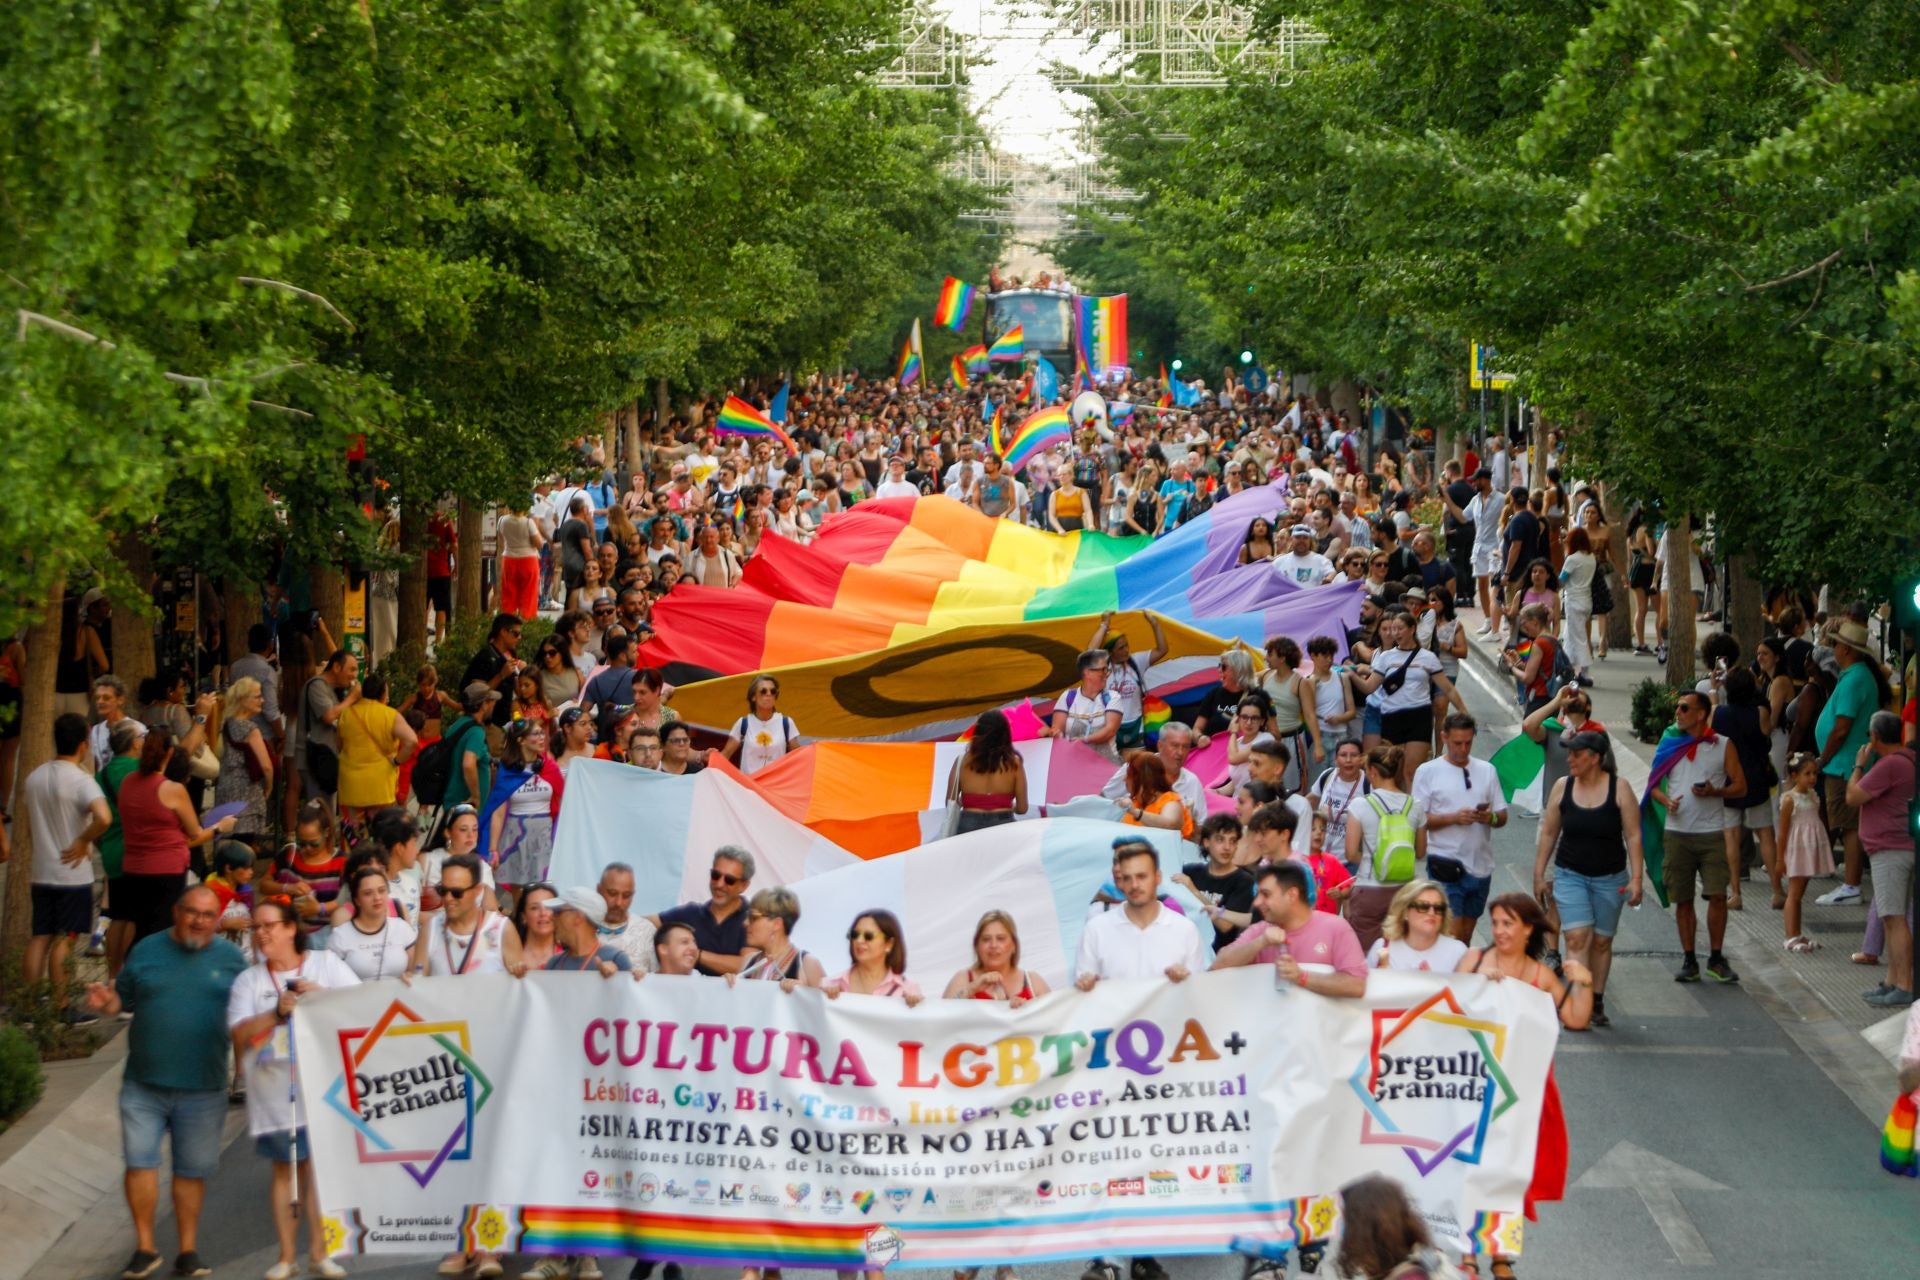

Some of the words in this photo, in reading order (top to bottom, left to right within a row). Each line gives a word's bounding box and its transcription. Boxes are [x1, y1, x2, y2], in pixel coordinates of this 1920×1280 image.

[583, 1018, 877, 1087] CULTURA
[897, 1017, 1247, 1089] LGBTIQA+
[673, 1083, 727, 1113] Gay,
[734, 1086, 793, 1118] Bi+,
[800, 1093, 899, 1127] Trans,
[908, 1101, 1000, 1124] Inter,
[1010, 1088, 1111, 1117] Queer,
[1119, 1073, 1248, 1102] Asexual
[790, 1126, 910, 1155] QUEER
[922, 1131, 973, 1155] NO
[985, 1123, 1059, 1152] HAY
[1070, 1109, 1251, 1141] CULTURA!
[684, 1152, 777, 1171] LGBTIQA+
[785, 1157, 809, 1172] de
[816, 1159, 834, 1174] la
[840, 1162, 936, 1177] comisión
[944, 1154, 1053, 1179] provincial
[1061, 1146, 1142, 1167] Orgullo
[1150, 1141, 1240, 1158] Granada
[1058, 1183, 1088, 1197] UGT
[370, 1230, 416, 1242] Granada
[378, 1215, 393, 1226] La
[395, 1214, 442, 1228] provincia
